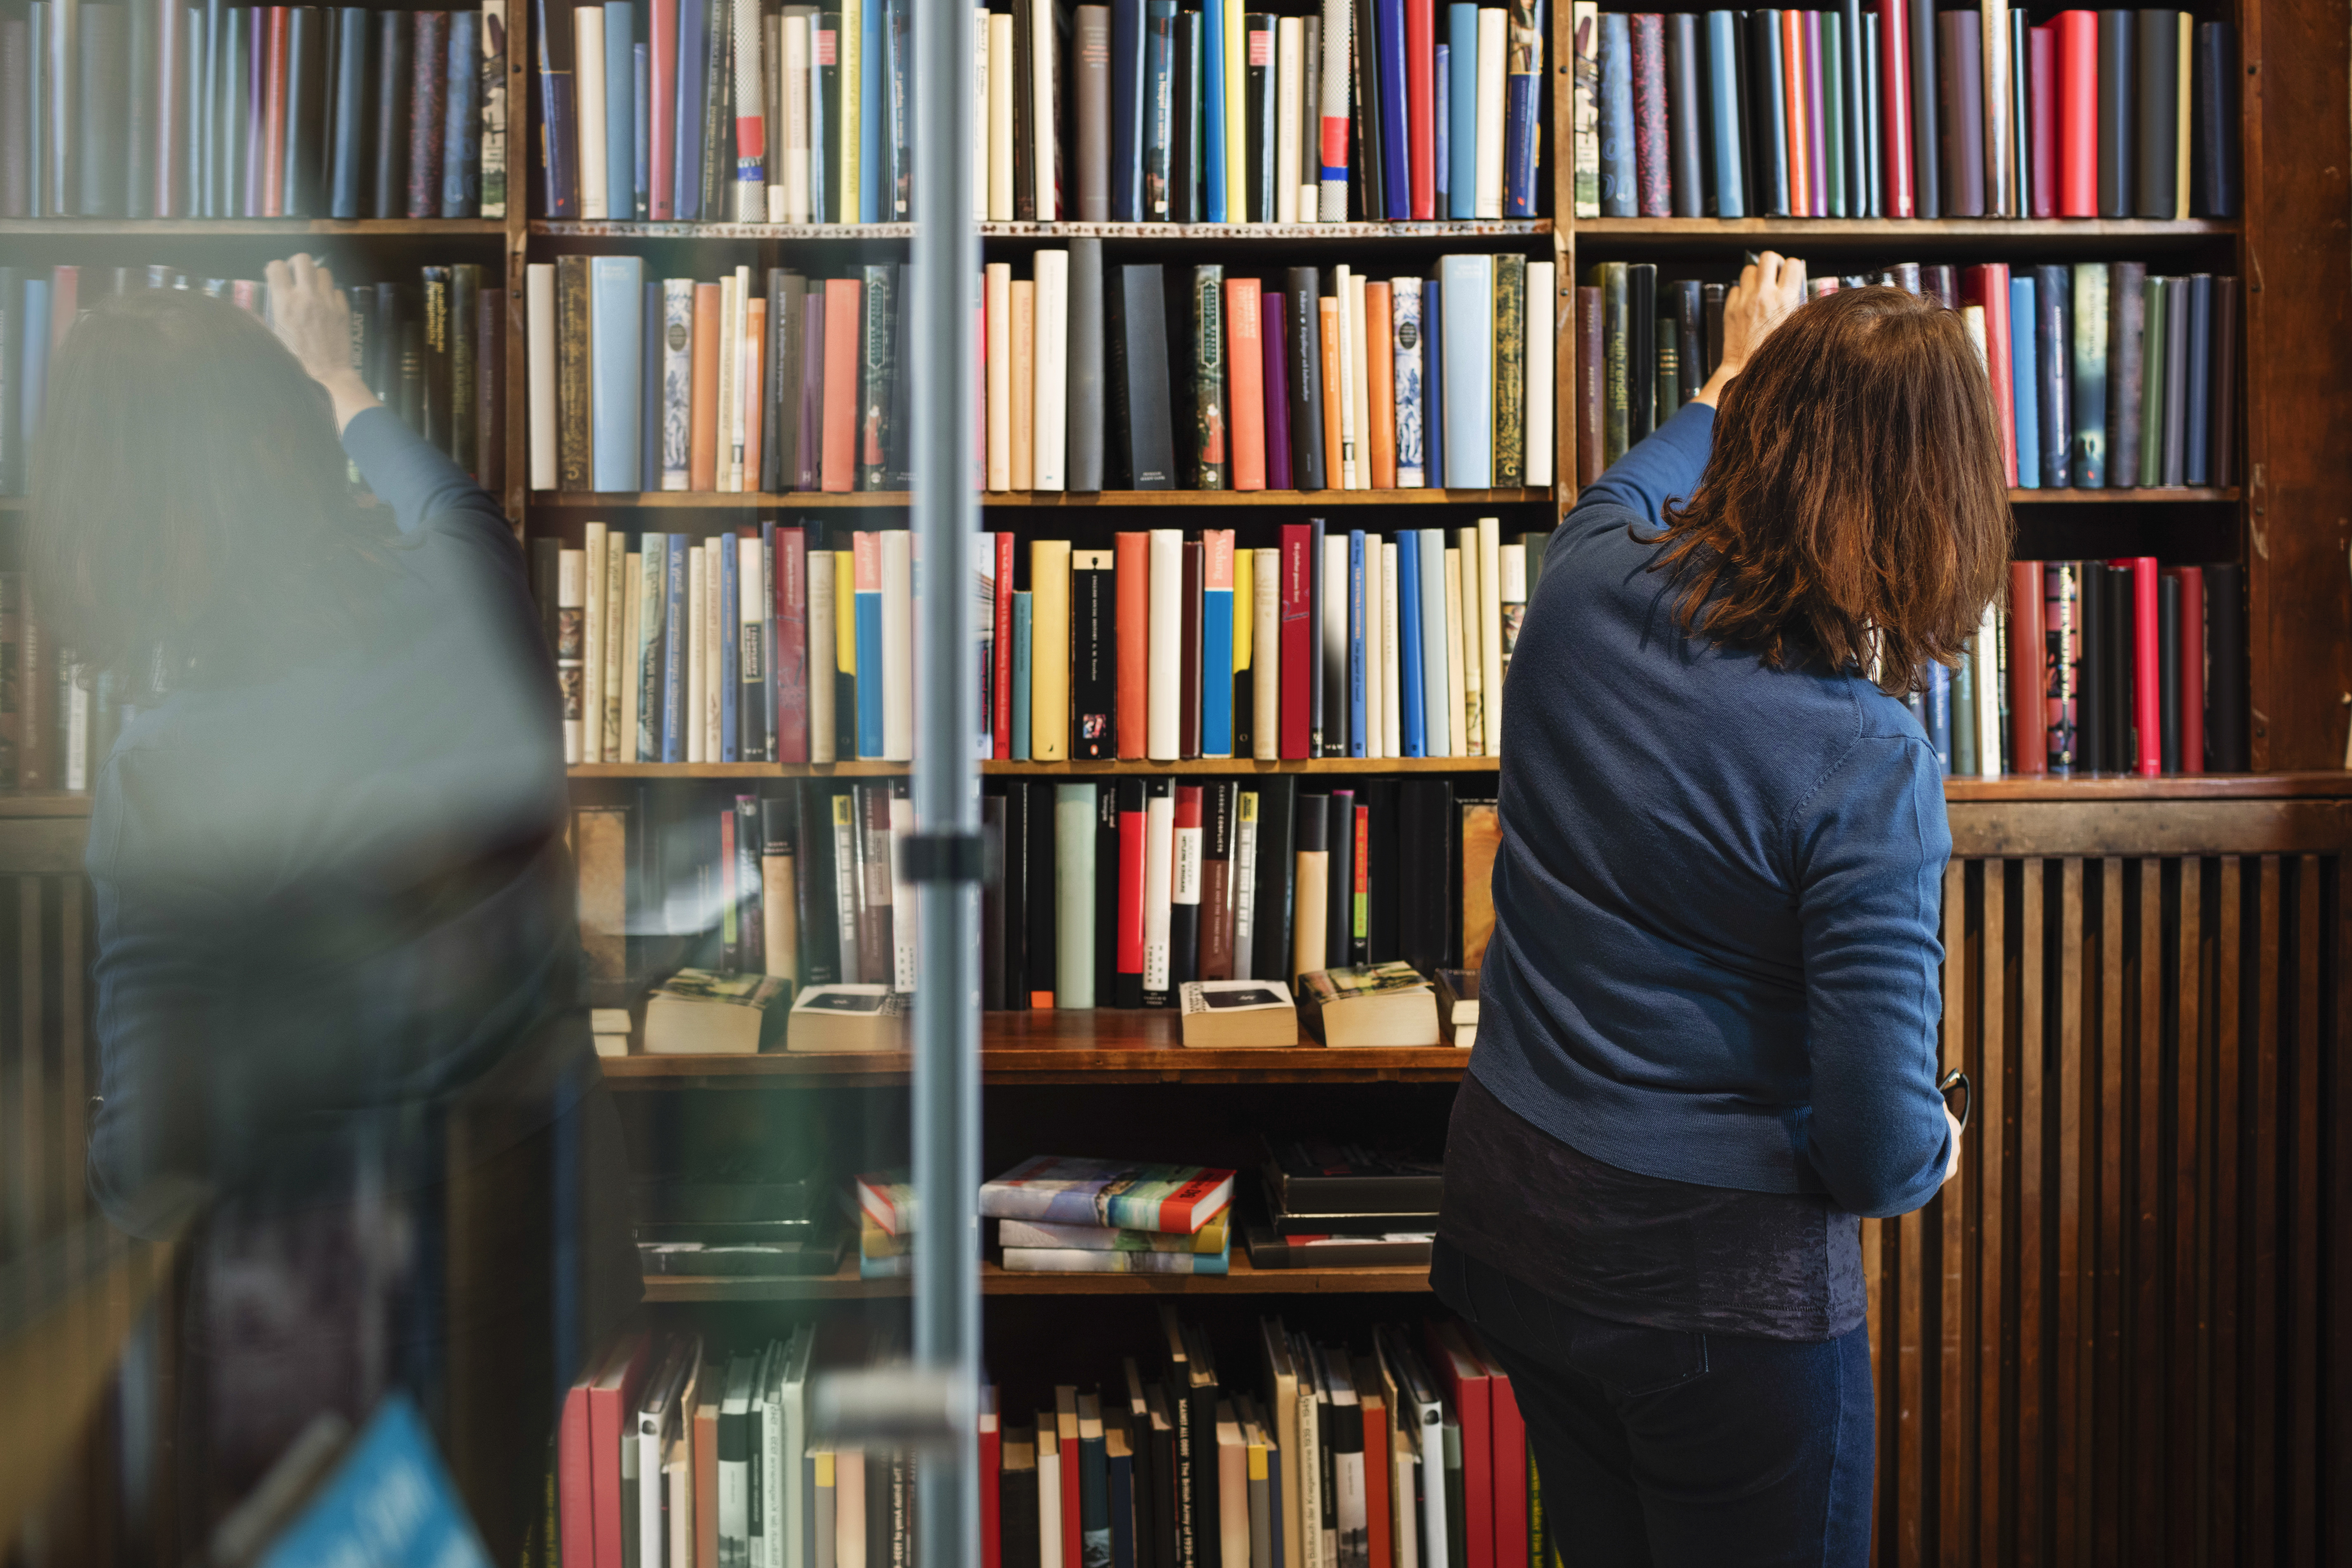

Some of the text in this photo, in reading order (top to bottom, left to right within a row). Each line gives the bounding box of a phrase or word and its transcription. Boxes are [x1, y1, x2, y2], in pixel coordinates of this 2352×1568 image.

[1616, 331, 1627, 409] ruth rendell
[1242, 827, 1253, 841] THE
[1240, 891, 1251, 907] DAY
[1240, 908, 1250, 919] BY
[1239, 920, 1249, 935] DAY
[1301, 1398, 1309, 1417] 1945
[1302, 1429, 1310, 1447] 1939
[1181, 1460, 1190, 1474] The
[1182, 1477, 1190, 1500] British
[1181, 1502, 1191, 1523] Army
[1184, 1524, 1193, 1533] of
